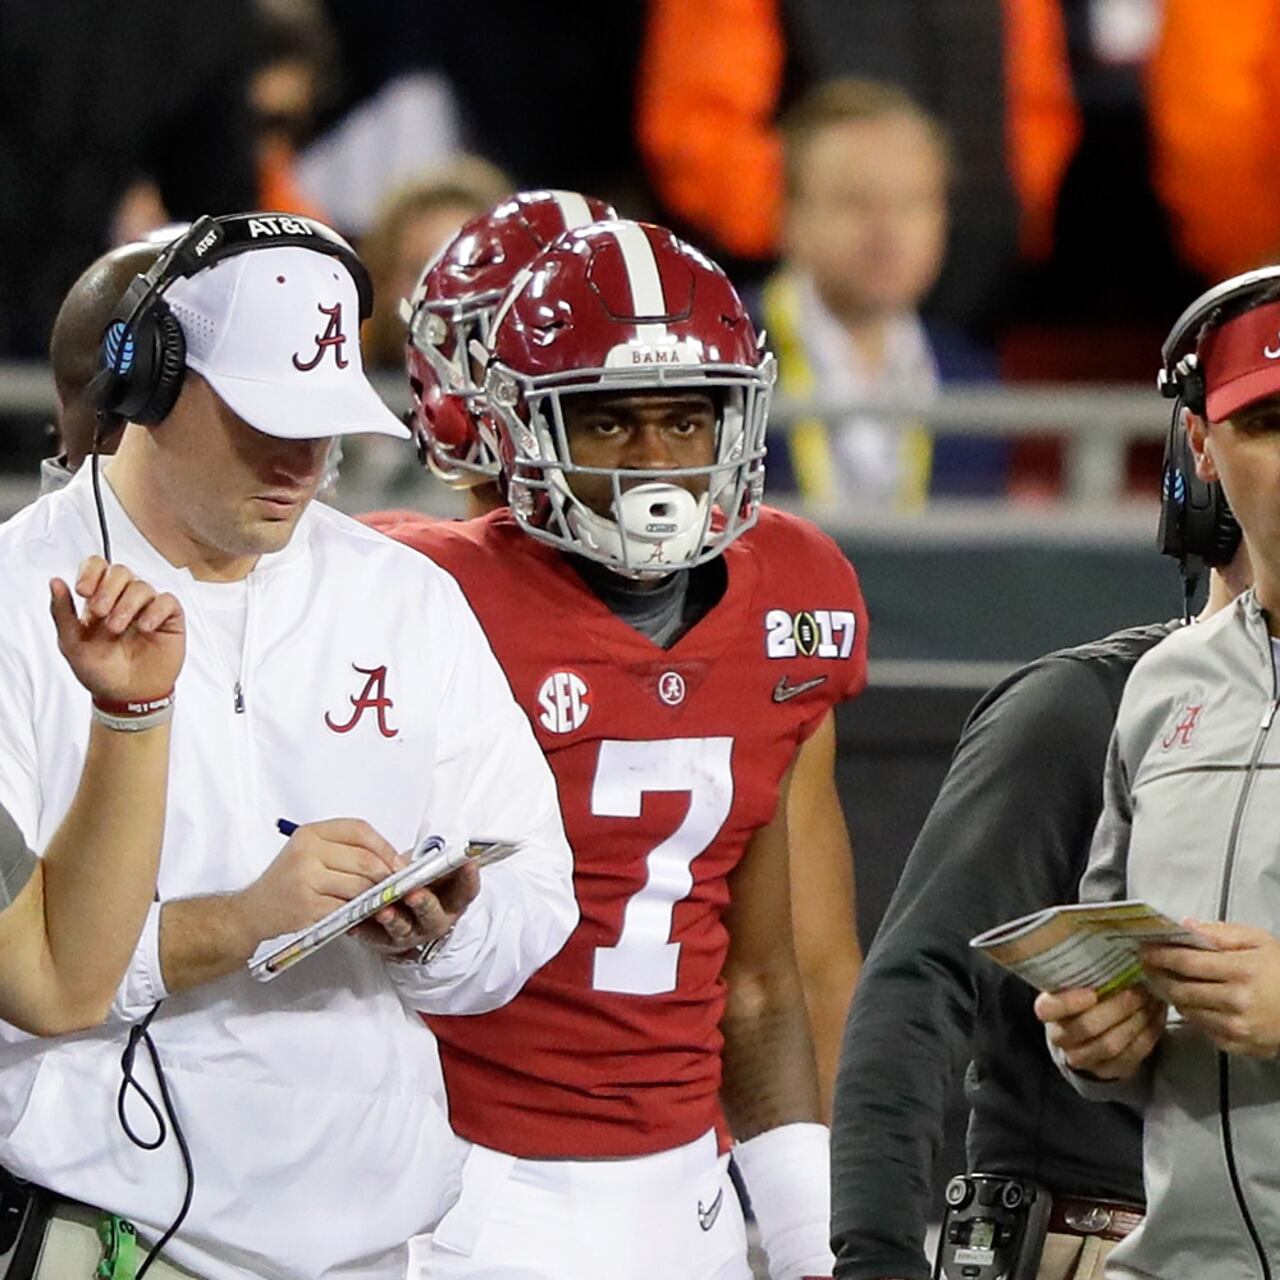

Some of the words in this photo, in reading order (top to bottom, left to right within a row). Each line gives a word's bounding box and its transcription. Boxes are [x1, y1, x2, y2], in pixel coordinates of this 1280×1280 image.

[194, 229, 218, 256] AT&T
[249, 216, 314, 239] AT&T
[292, 302, 349, 372] A
[632, 351, 681, 364] BAMA
[324, 662, 399, 738] A
[536, 671, 591, 734] SEC
[591, 736, 735, 996] 7
